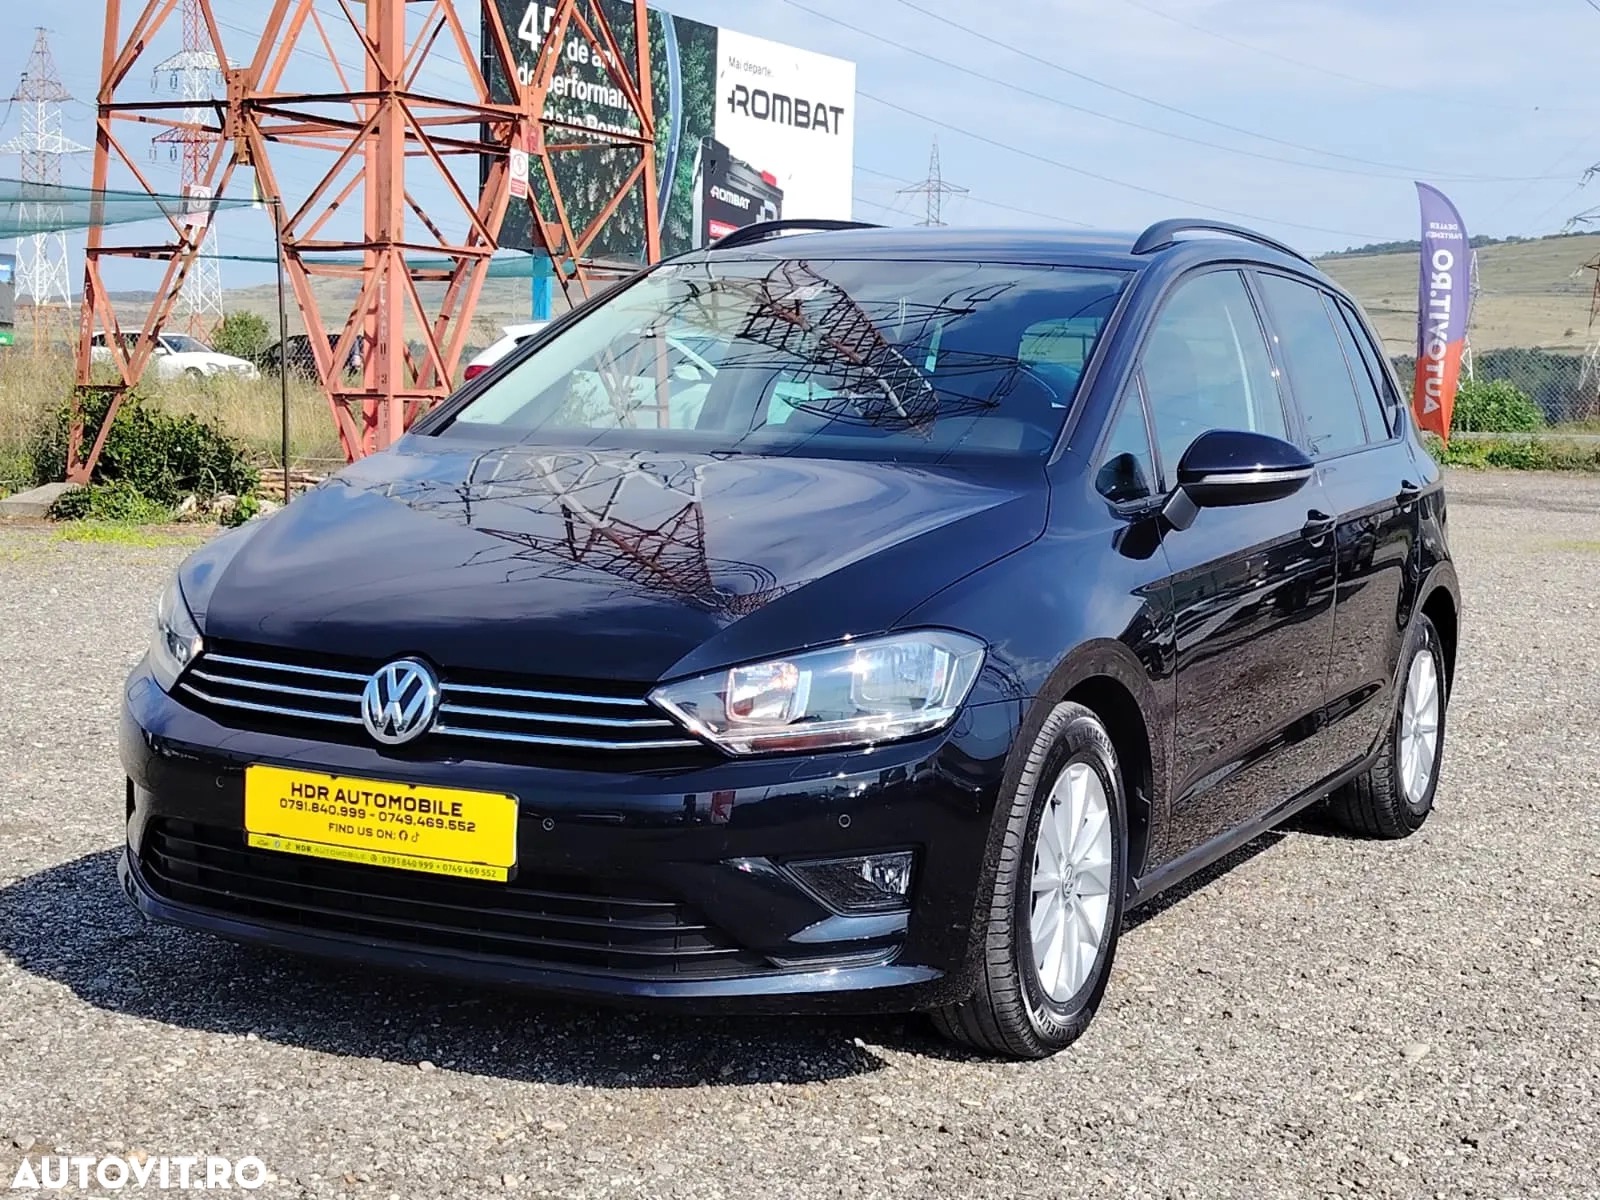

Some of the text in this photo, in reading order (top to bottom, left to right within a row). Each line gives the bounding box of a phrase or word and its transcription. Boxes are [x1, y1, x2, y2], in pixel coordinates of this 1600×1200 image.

[566, 37, 589, 64] de
[728, 55, 742, 70] Mai
[727, 83, 845, 136] ROMBAT
[710, 184, 751, 210] ROMBAT
[291, 782, 463, 818] HDR AUTOMOBILE
[280, 797, 366, 819] 0791.840.999
[378, 811, 476, 832] 0749.469.552
[328, 822, 396, 840] FIND US ON:
[295, 844, 366, 860] HDR AUTOMOBILE
